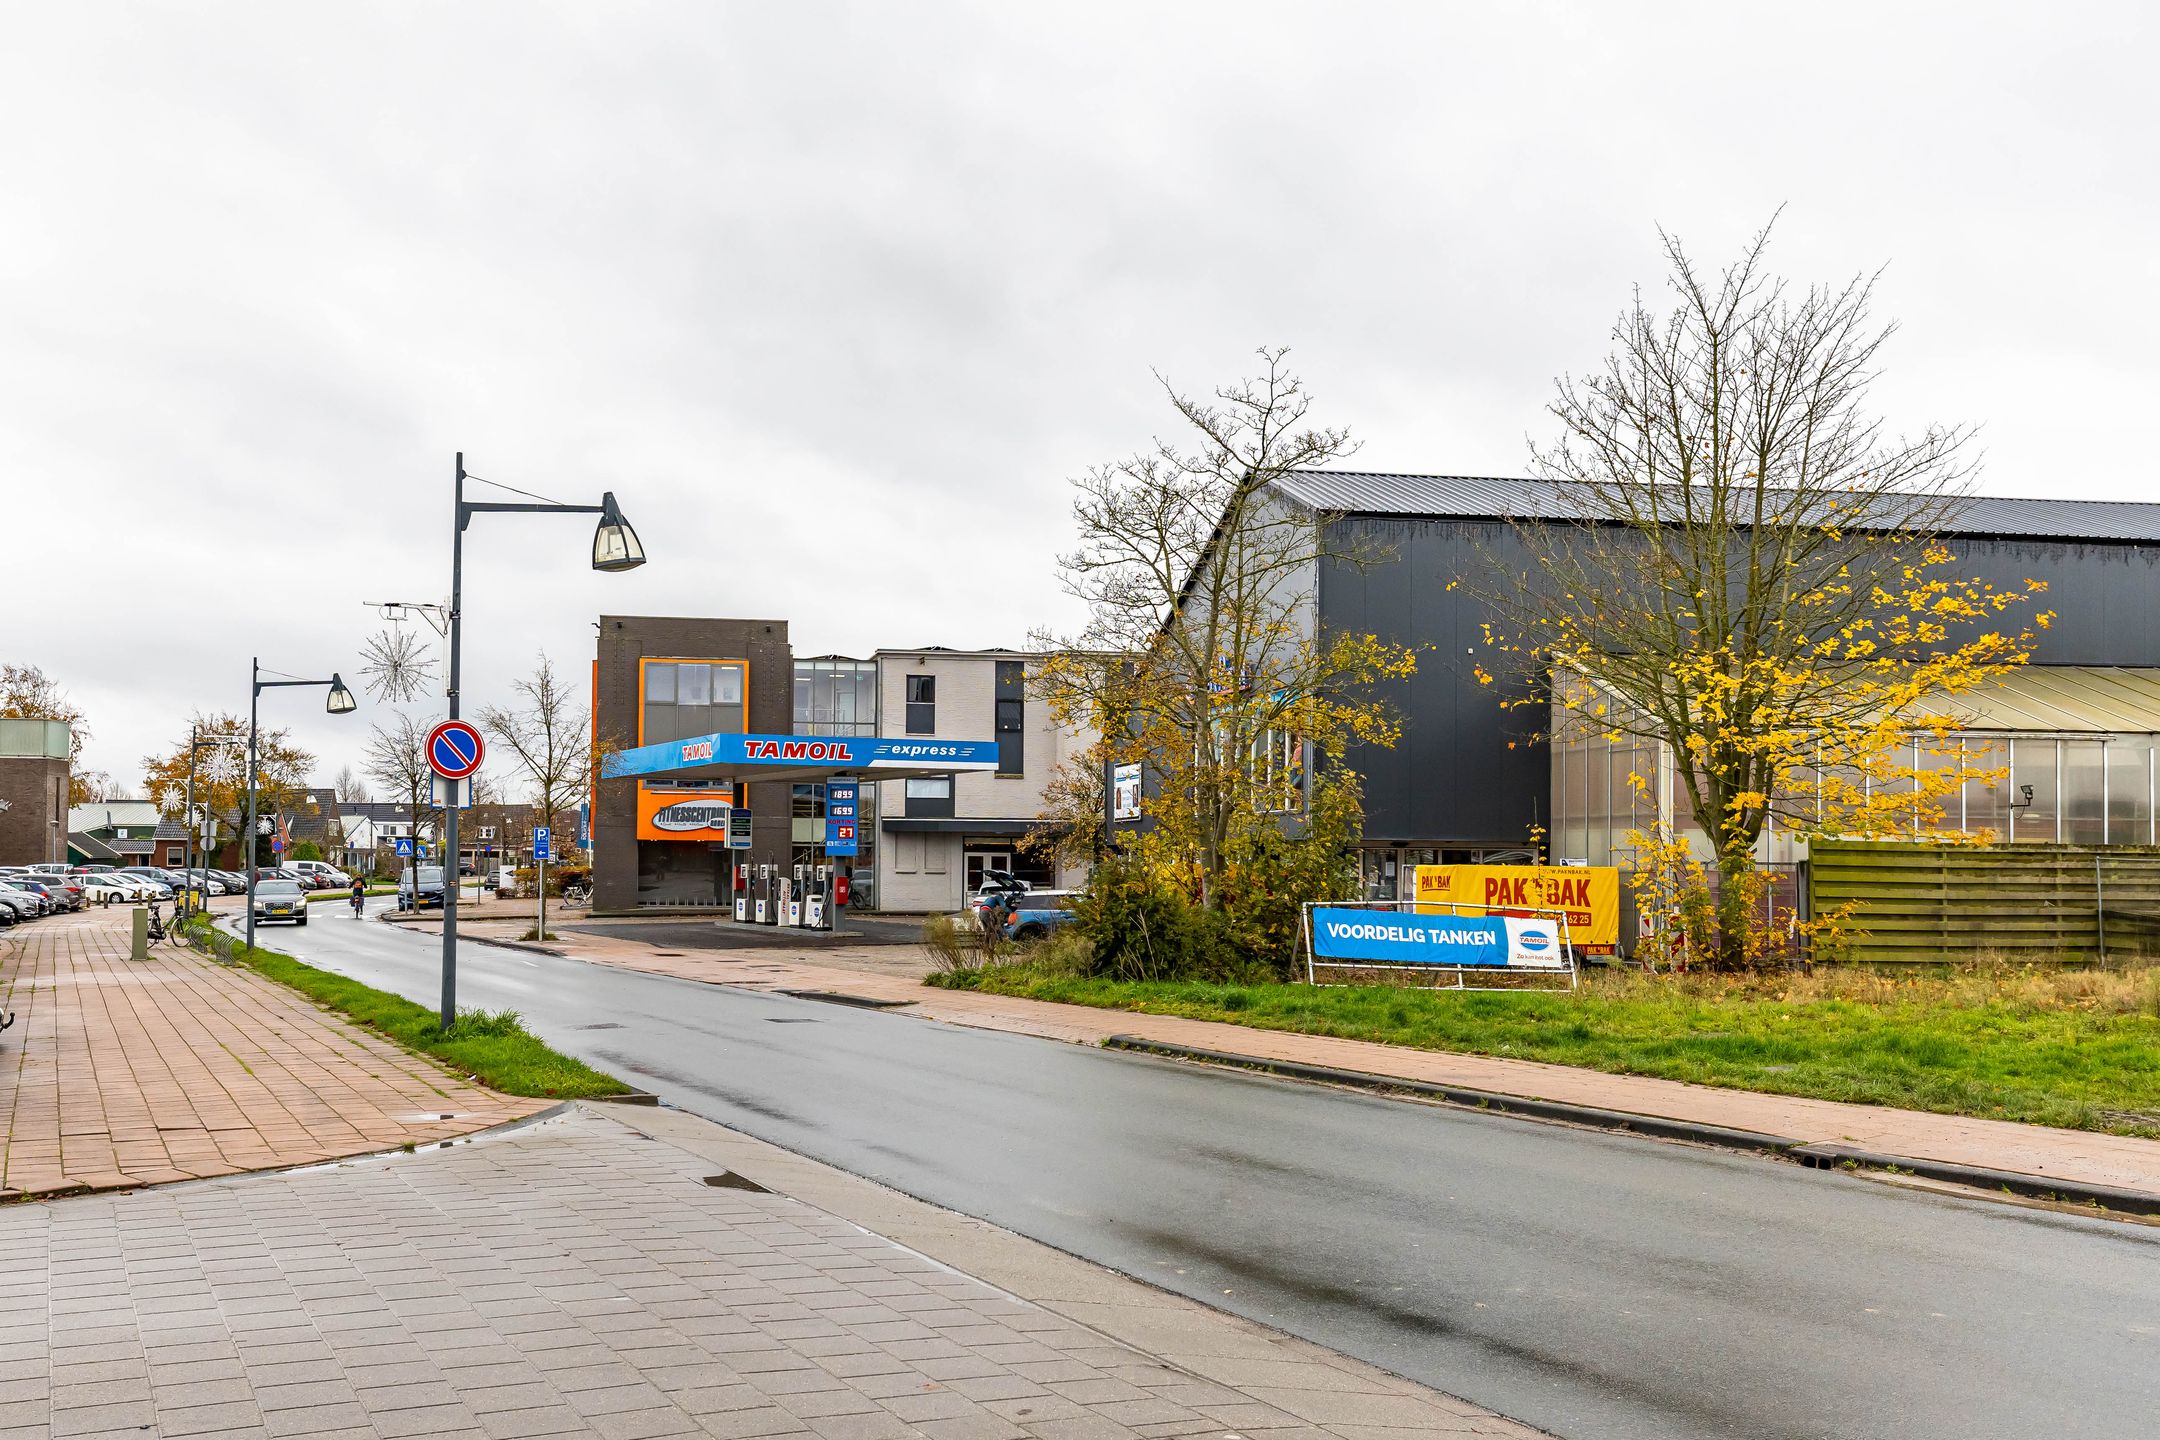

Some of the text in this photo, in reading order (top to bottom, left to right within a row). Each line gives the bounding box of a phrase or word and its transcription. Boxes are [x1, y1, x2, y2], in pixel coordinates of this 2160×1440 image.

[682, 741, 712, 761] TAMOIL
[744, 741, 853, 761] TAMOIL
[891, 745, 957, 757] express
[537, 829, 547, 841] P
[1421, 875, 1433, 889] PAK
[1437, 875, 1451, 889] BAK
[1485, 877, 1529, 905] PAK
[1546, 878, 1591, 907] BAK
[1568, 914, 1578, 924] 62
[1579, 914, 1589, 924] 25
[1327, 922, 1496, 946] VOORDELIG TANKEN
